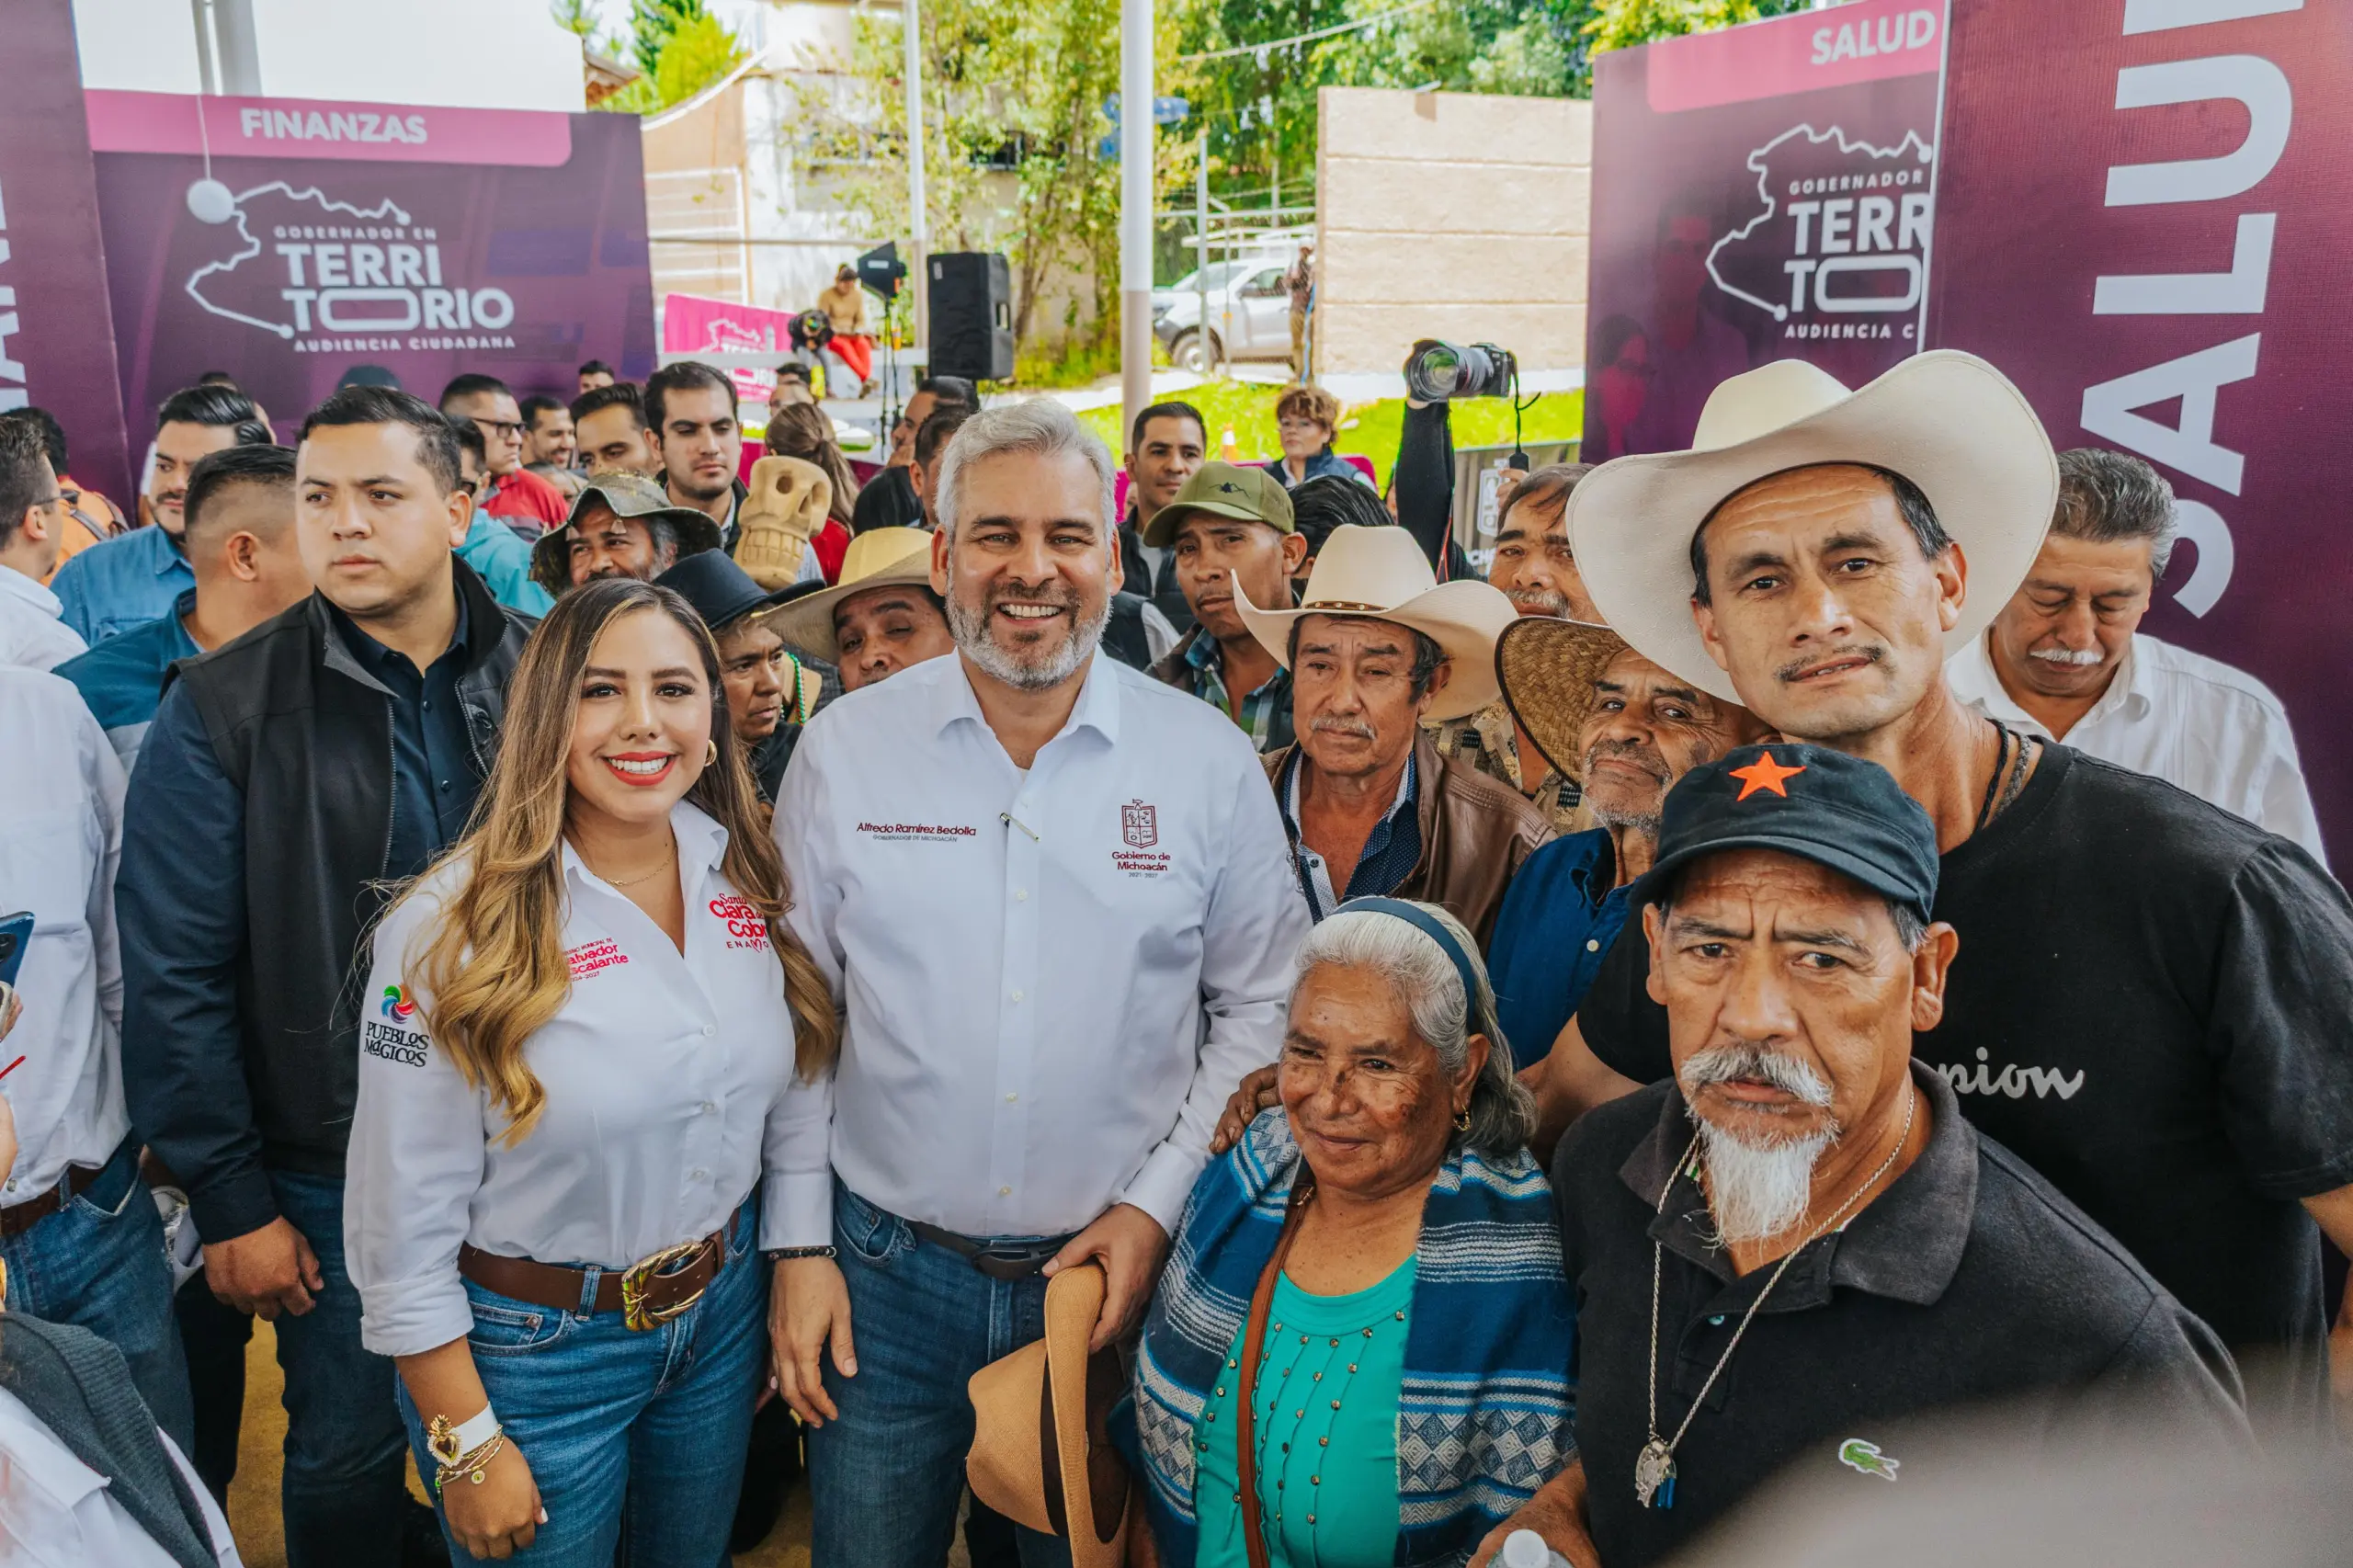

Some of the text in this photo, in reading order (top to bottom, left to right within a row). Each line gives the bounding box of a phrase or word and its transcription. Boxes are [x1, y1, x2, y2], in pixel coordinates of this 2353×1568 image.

[1811, 9, 1936, 64] SALUD
[239, 108, 428, 144] FINANZAS
[1789, 169, 1924, 196] GOBERNADOR
[274, 226, 437, 241] GOBERNADOR EN
[1787, 192, 1933, 256] TERR
[276, 244, 443, 287] TERRI
[1784, 254, 1923, 312] TO
[281, 288, 515, 332] TORIO
[2081, 0, 2304, 619] SALU
[1784, 324, 1892, 339] AUDIENCIA
[293, 336, 516, 352] AUDIENCIA CIUDADANA
[857, 823, 976, 836] Alfredo Ramírez Bedolla
[1111, 850, 1171, 861] Gobierno de
[1117, 861, 1167, 871] Michoacán
[710, 900, 756, 919] Clara
[727, 919, 767, 937] Cobr
[568, 945, 619, 966] alvador
[571, 954, 629, 974] scalante
[1938, 1046, 2085, 1100] pion
